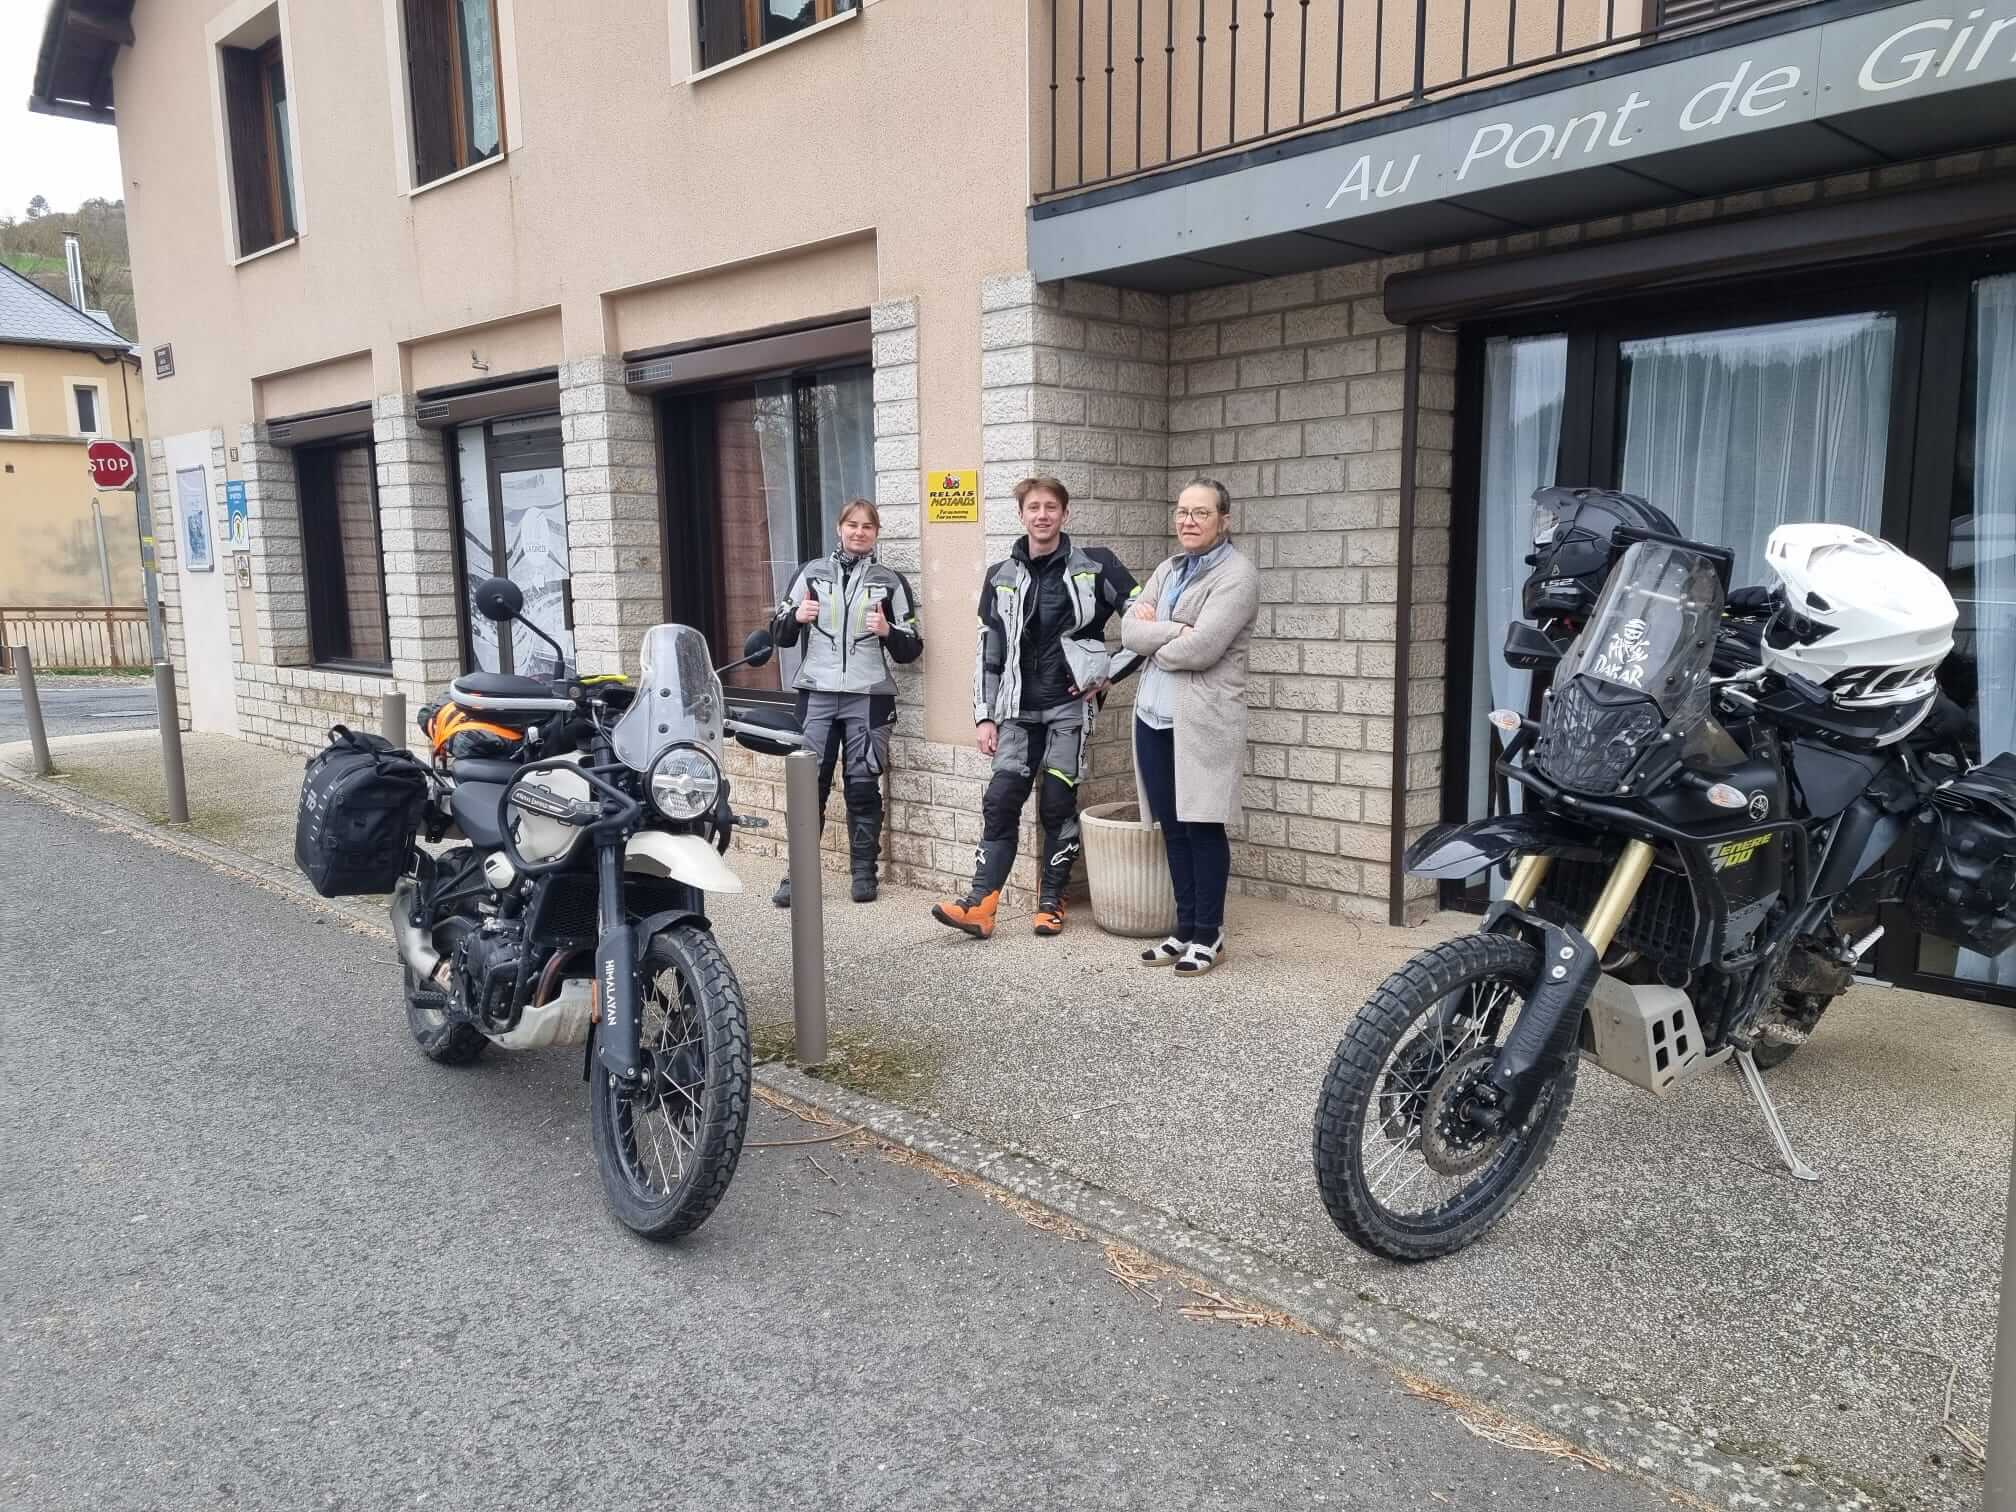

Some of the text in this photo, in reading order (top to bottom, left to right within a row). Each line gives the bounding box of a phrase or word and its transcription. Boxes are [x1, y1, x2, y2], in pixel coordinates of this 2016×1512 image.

[1325, 154, 1421, 209] Au
[1456, 91, 1651, 182] Pont
[1679, 60, 1801, 131] de
[88, 457, 129, 472] STOP
[929, 490, 975, 498] RELAIS
[930, 496, 976, 507] MOTARDS
[1591, 653, 1645, 689] DAKAR
[605, 959, 617, 1027] HIMALAYAN
